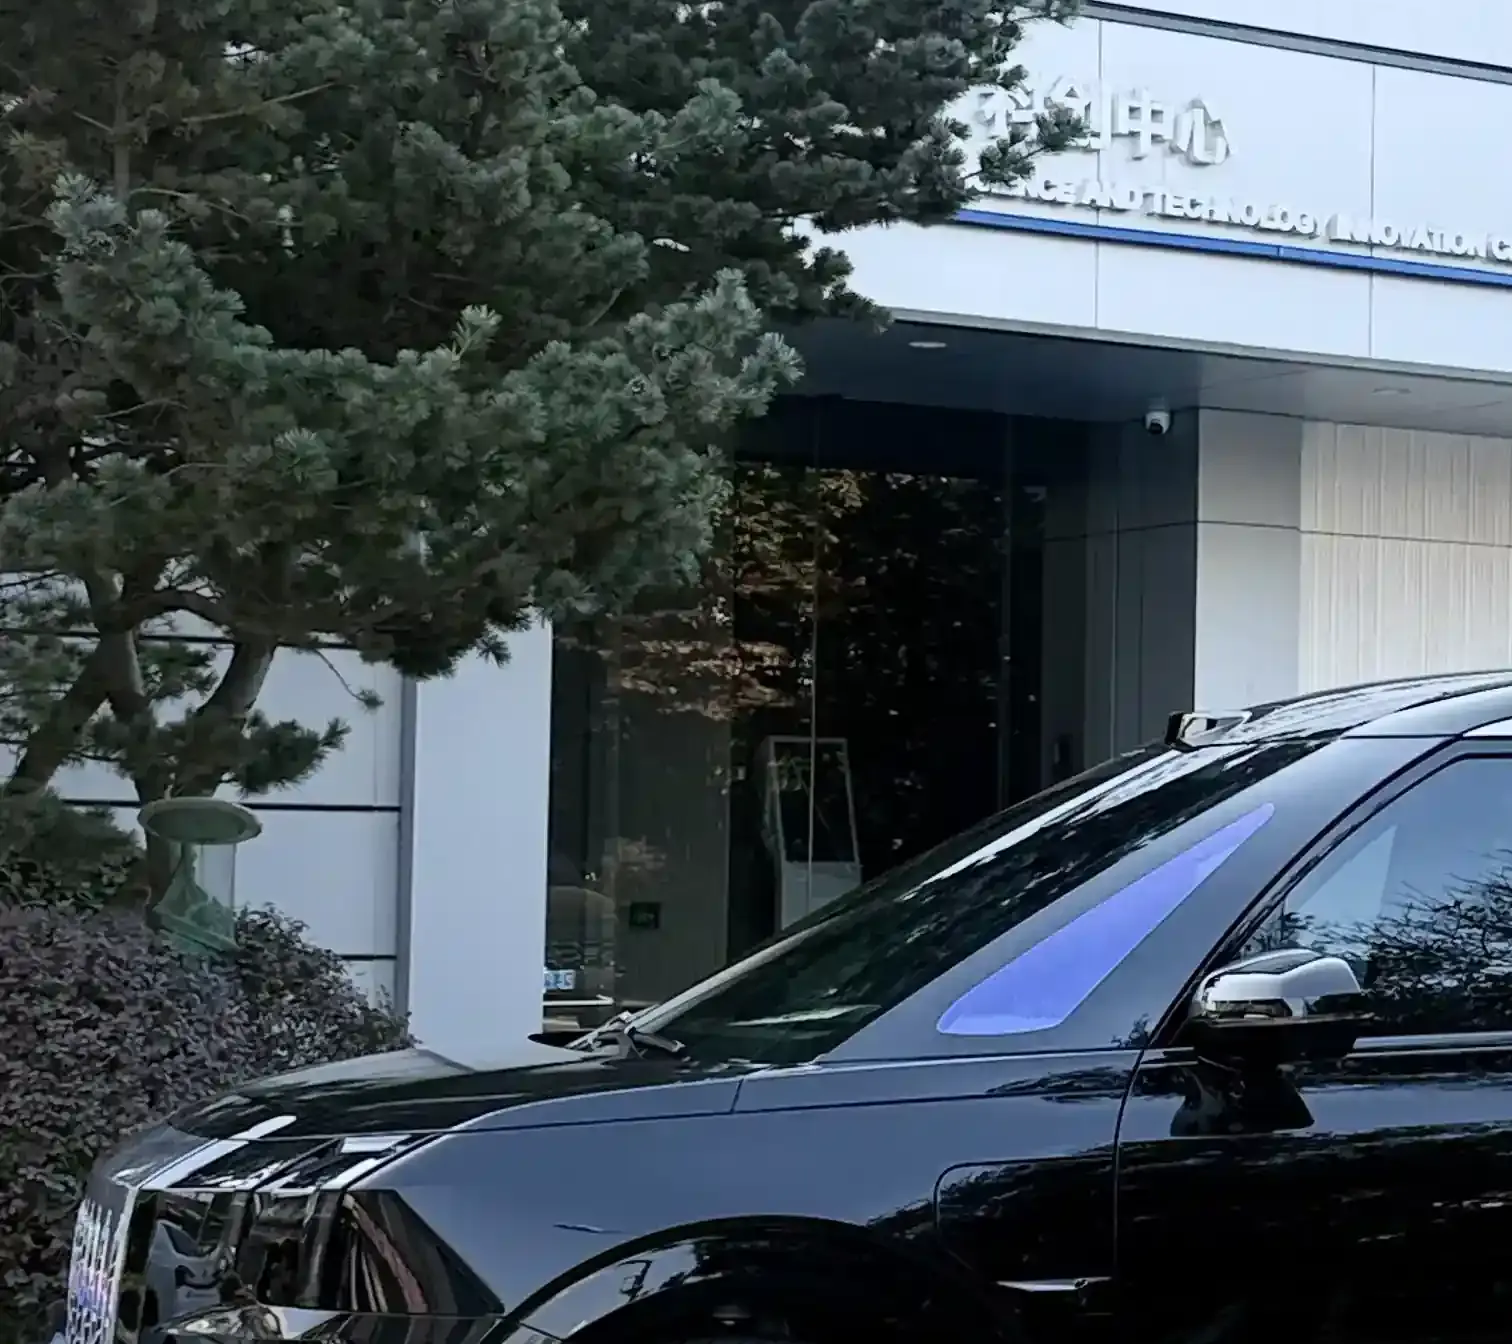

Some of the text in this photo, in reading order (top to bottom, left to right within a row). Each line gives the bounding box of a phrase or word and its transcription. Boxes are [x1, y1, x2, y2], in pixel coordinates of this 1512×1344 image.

[1079, 177, 1146, 212] AND
[1146, 184, 1324, 240] TECHNOLOGY
[1330, 212, 1488, 260] INNOVATION
